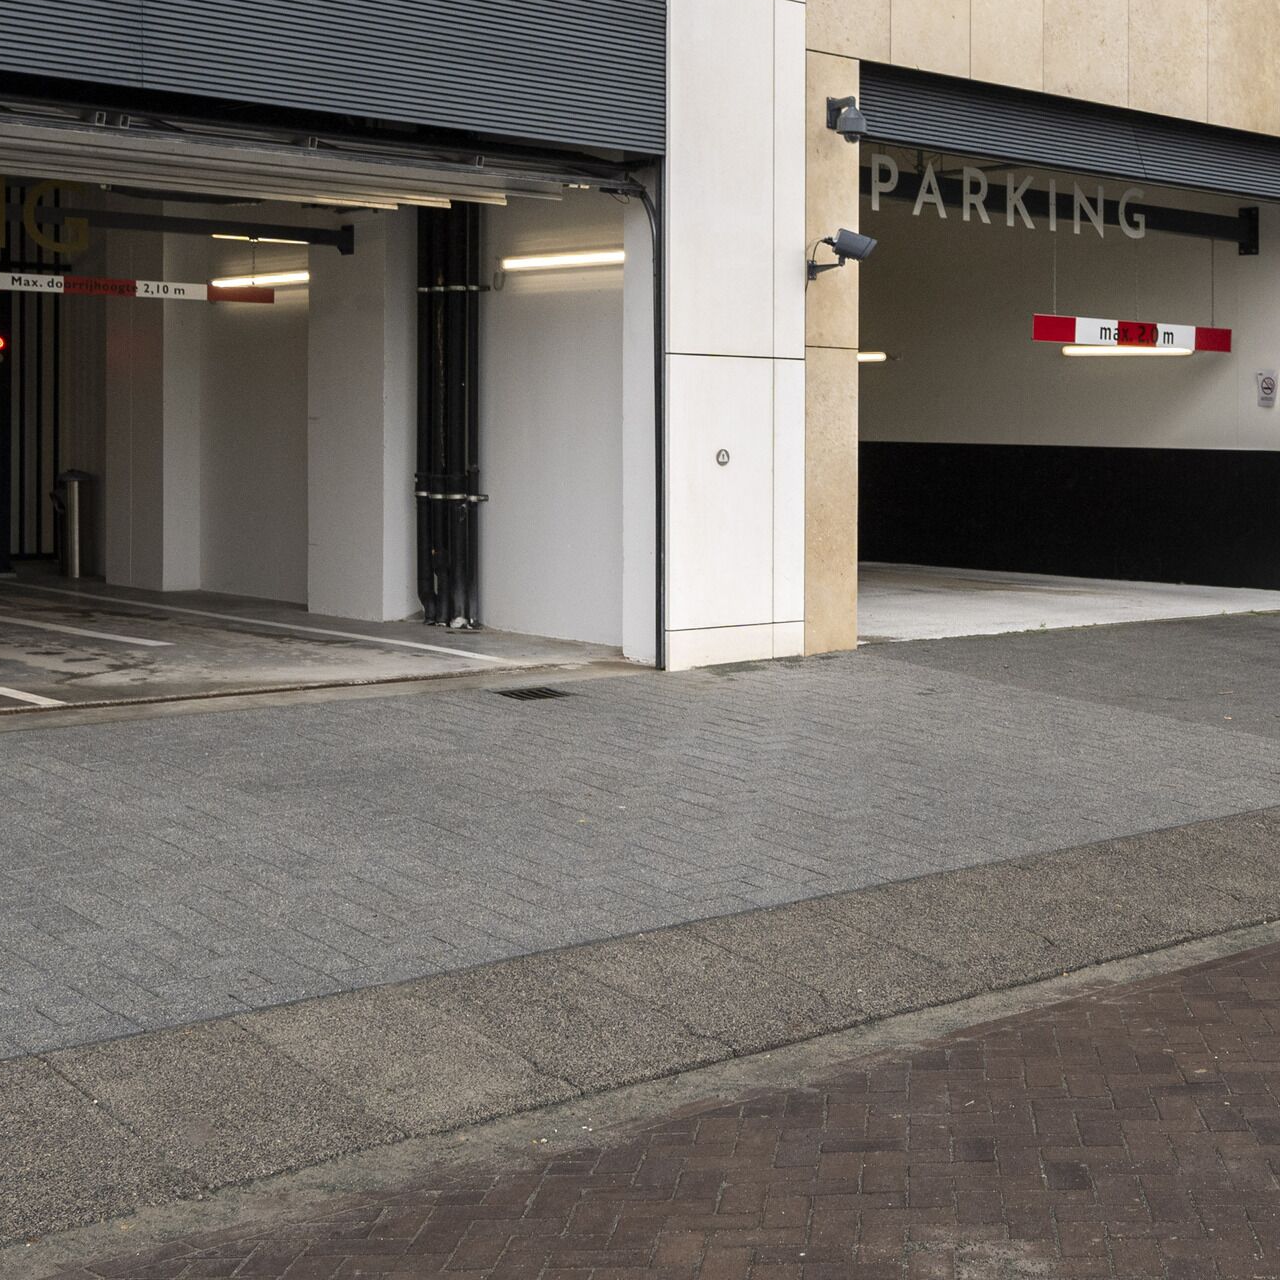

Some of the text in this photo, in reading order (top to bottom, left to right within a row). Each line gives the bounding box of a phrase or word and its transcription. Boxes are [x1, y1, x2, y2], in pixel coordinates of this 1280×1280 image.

[871, 154, 1146, 239] PARKING
[11, 276, 185, 296] Max. doorrijhoogte 2,10 m
[1099, 326, 1133, 342] max.
[1163, 330, 1174, 345] m
